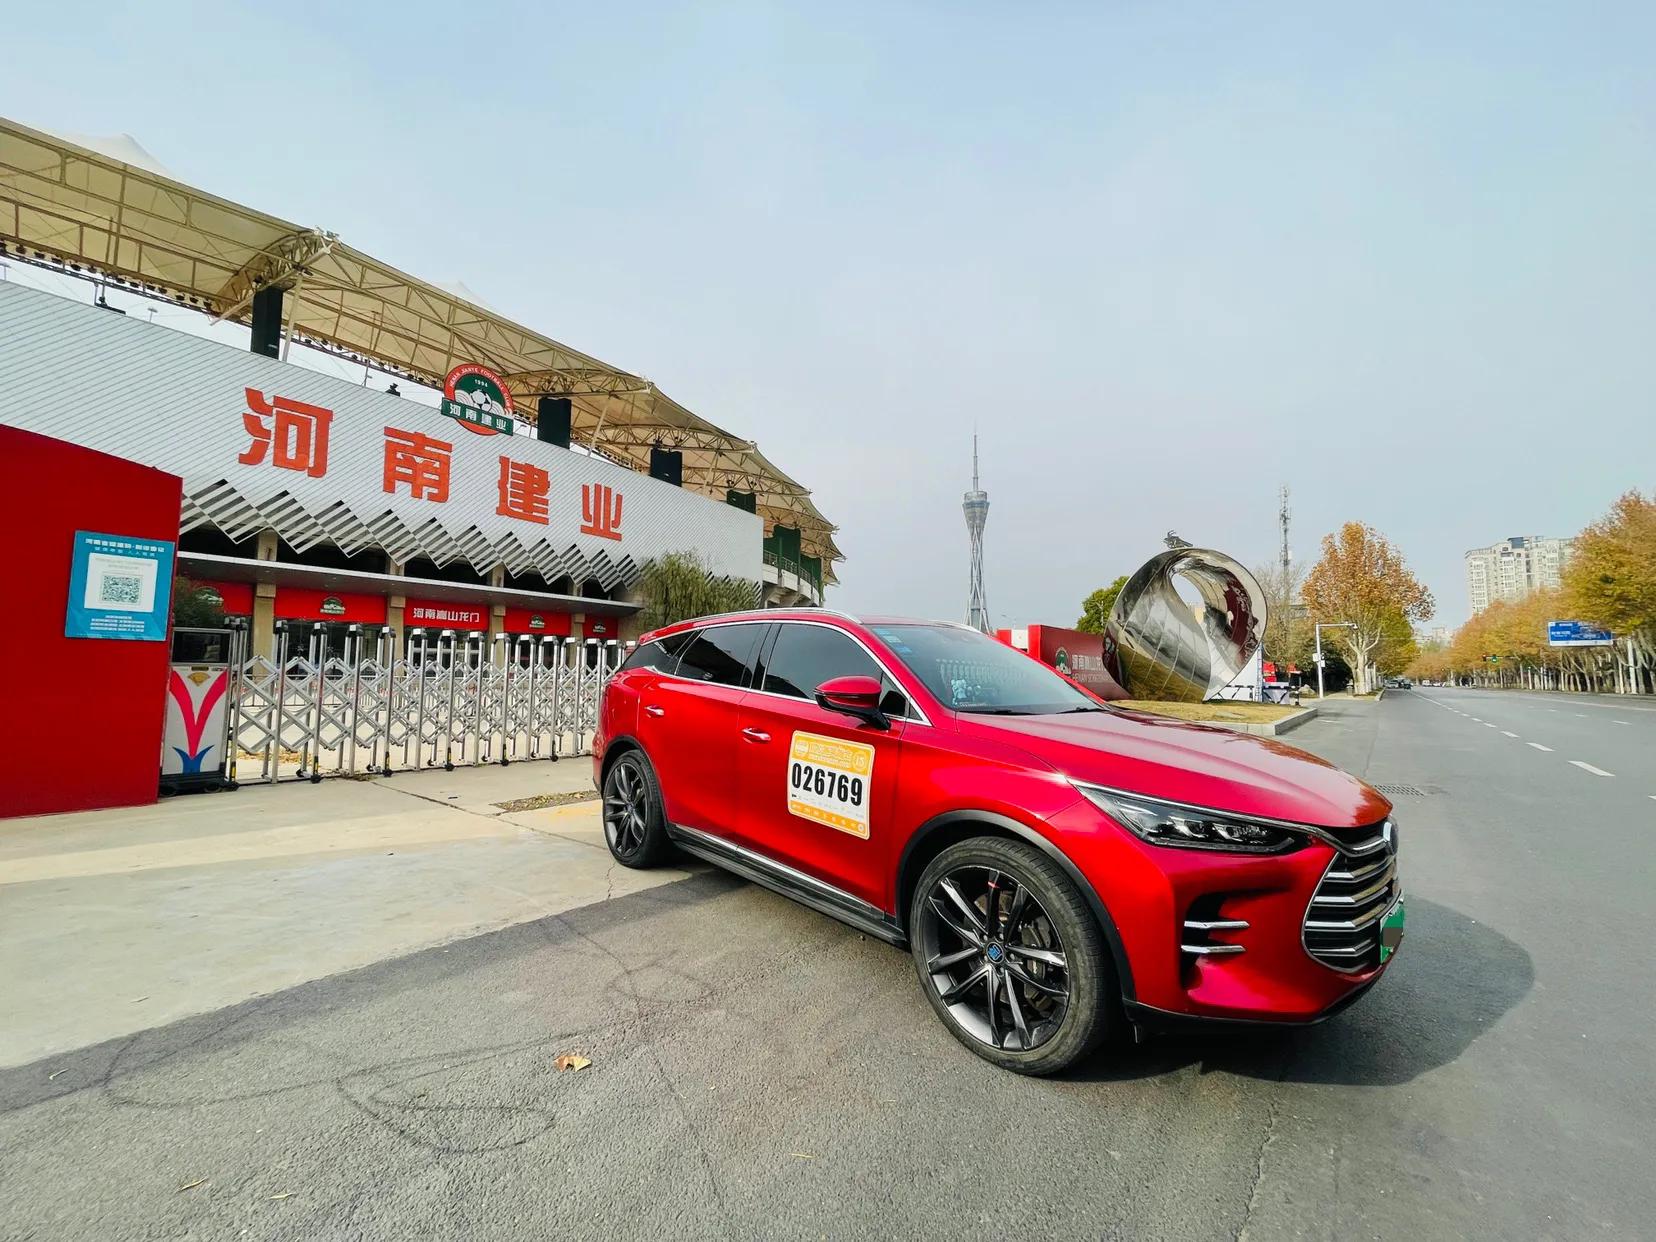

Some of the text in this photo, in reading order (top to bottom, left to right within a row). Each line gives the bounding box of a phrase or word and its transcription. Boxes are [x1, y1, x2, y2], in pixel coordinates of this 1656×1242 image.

[474, 379, 488, 388] 1994
[480, 369, 505, 391] FOOTBALL
[449, 403, 507, 431] 河南建业
[238, 386, 623, 542] 河南建业
[412, 607, 480, 623] 河南嵩山龙门
[791, 762, 863, 807] 026769
